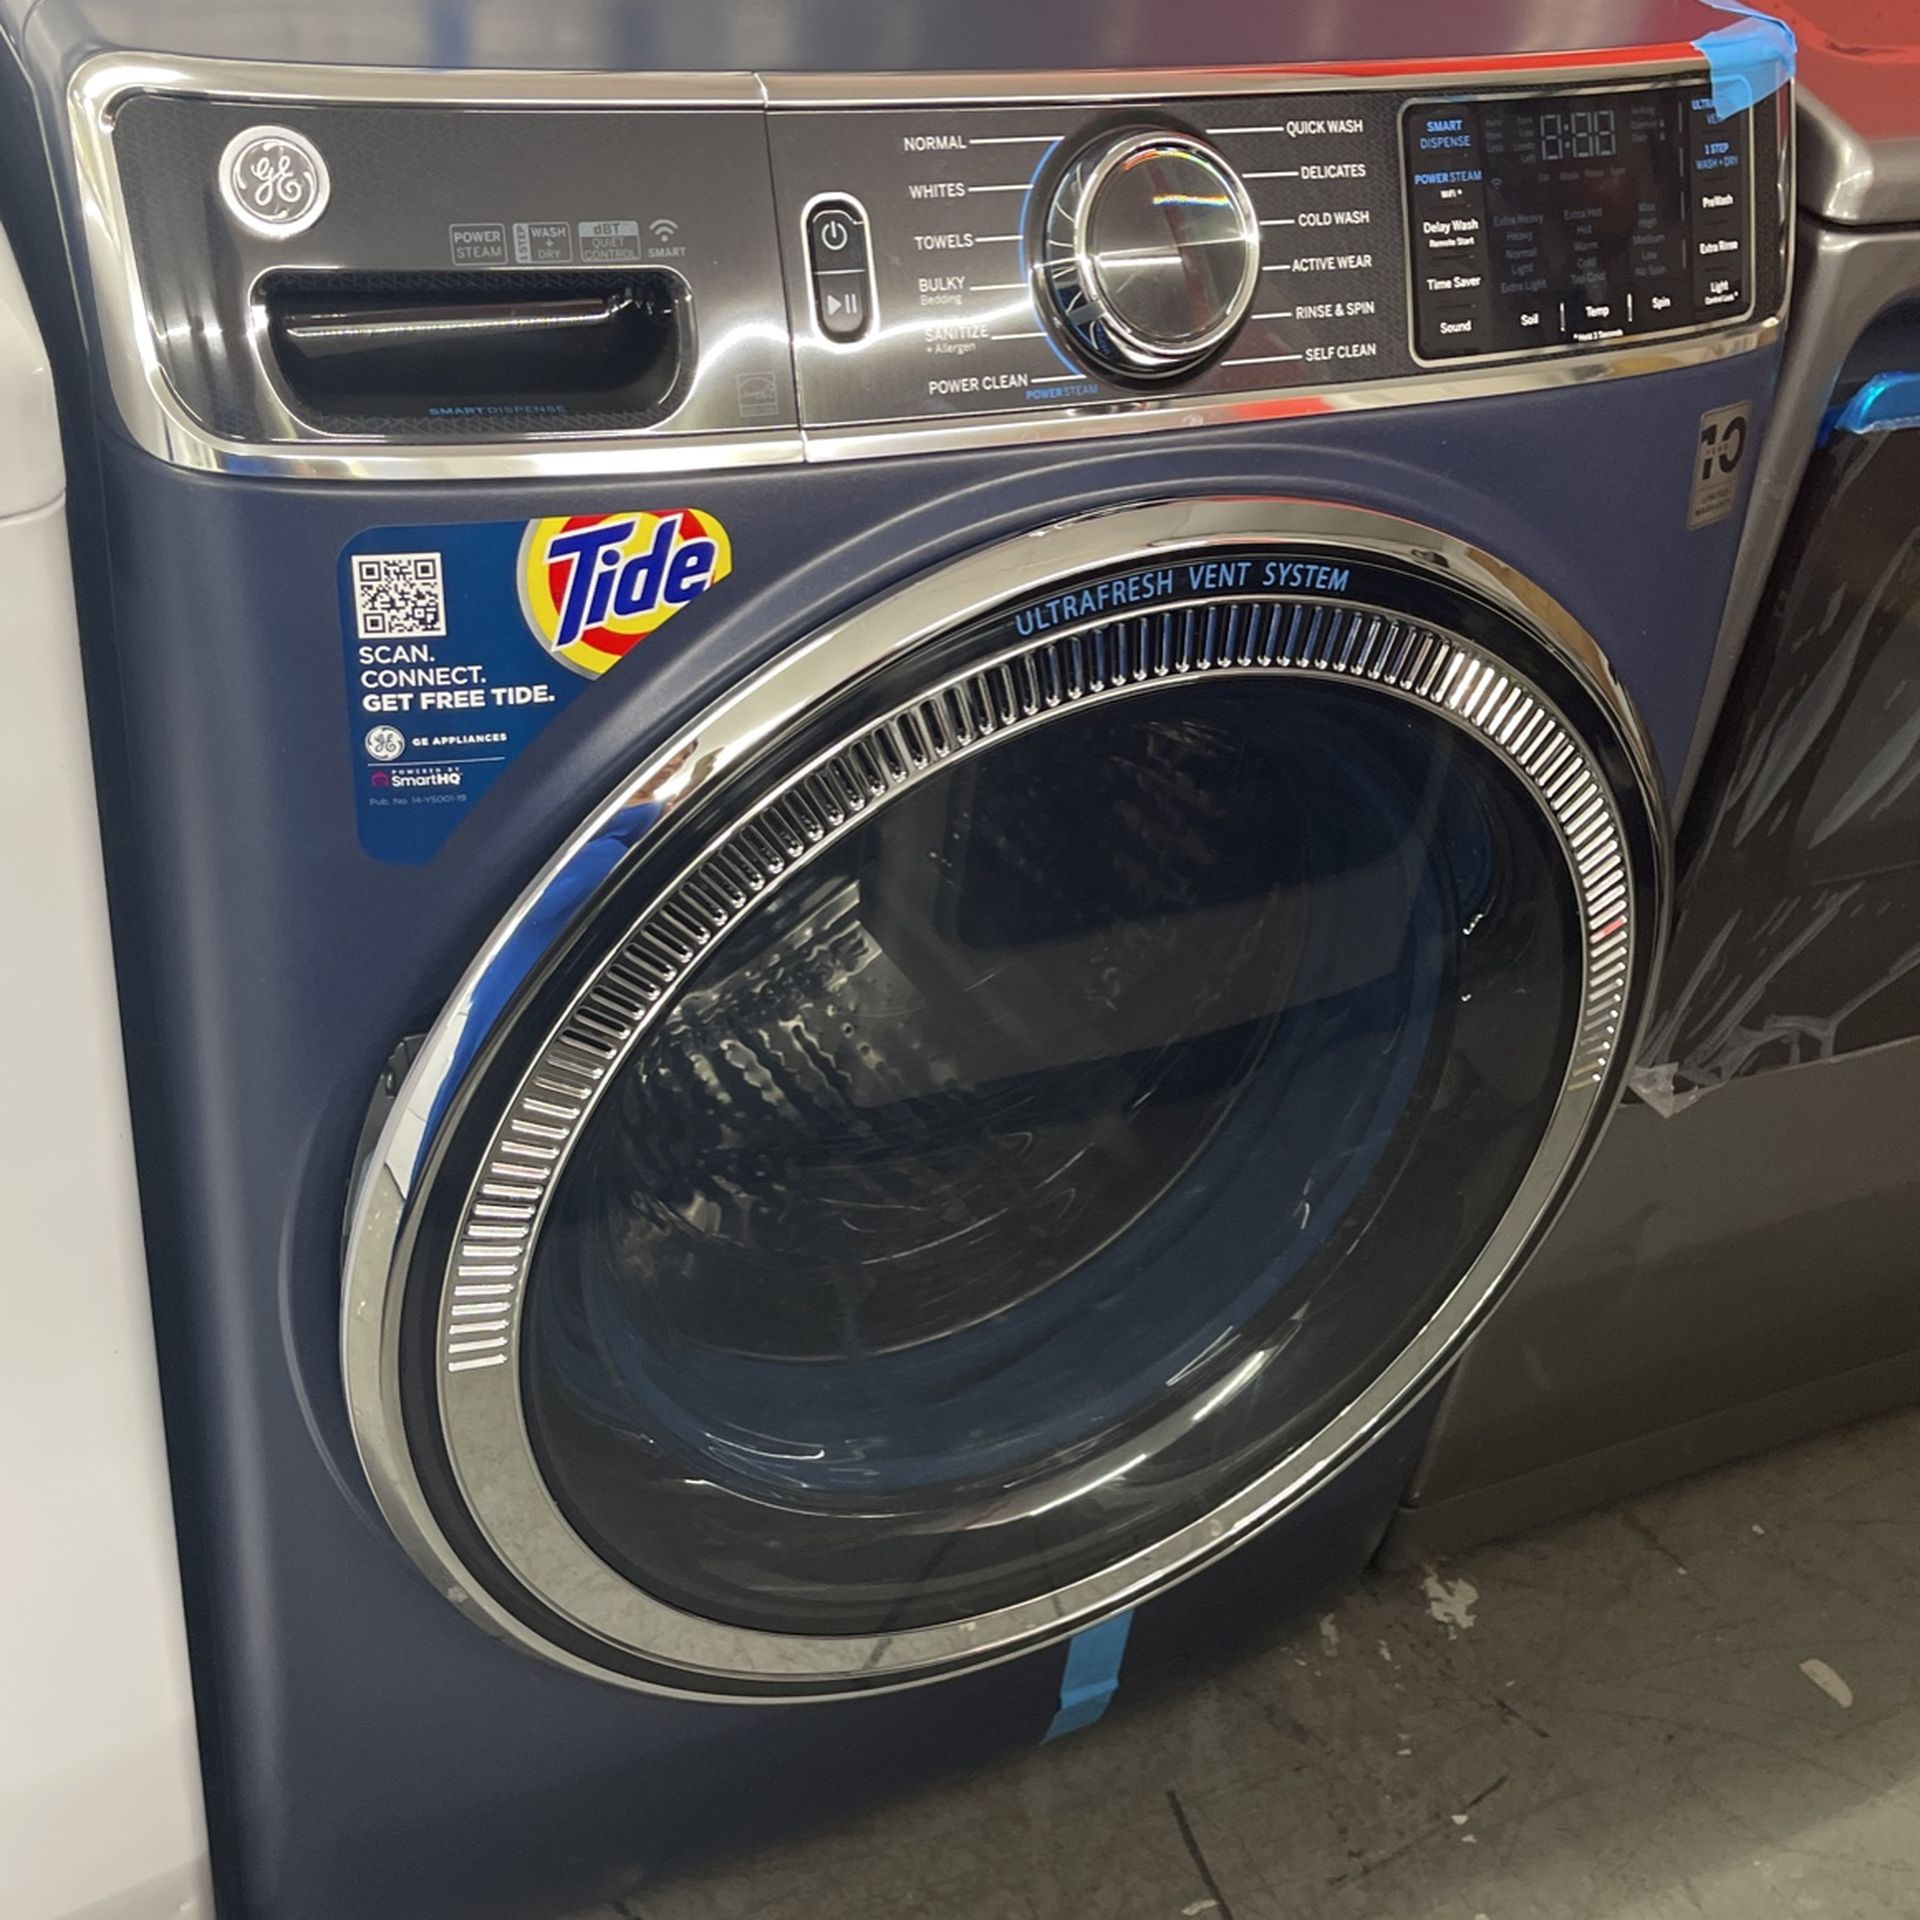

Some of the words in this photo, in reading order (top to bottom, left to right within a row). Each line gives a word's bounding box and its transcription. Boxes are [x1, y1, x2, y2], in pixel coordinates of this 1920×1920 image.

[1286, 120, 1326, 138] QUICK
[1326, 119, 1364, 133] WASH
[1426, 119, 1463, 132] SMART
[903, 135, 967, 151] NORMAL
[1420, 135, 1471, 149] DISPENSE
[1710, 142, 1729, 154] STEP
[1696, 159, 1718, 170] WASH
[1724, 155, 1738, 167] DRY
[1301, 163, 1366, 180] DELICATES
[908, 182, 966, 199] WHITES
[1298, 212, 1332, 227] COLD
[1333, 210, 1370, 224] WASH
[531, 227, 566, 238] WASH
[1423, 220, 1450, 234] Delay
[1451, 218, 1479, 231] Wash
[454, 231, 501, 243] POWER
[592, 237, 624, 248] QUIET
[914, 233, 974, 251] TOWELS
[1456, 237, 1474, 246] Start
[457, 246, 502, 259] STEAM
[584, 248, 634, 260] CONTROL
[649, 246, 687, 258] SMART
[1700, 242, 1719, 254] Extra
[1719, 240, 1738, 252] Rinse
[538, 249, 561, 260] DRY
[1292, 256, 1336, 272] ACTIVE
[1336, 254, 1372, 269] WEAR
[918, 276, 965, 293] BULKY
[1427, 278, 1452, 290] Time
[1452, 276, 1481, 288] Saver
[1710, 280, 1728, 294] Light
[920, 295, 963, 306] Bedding
[1652, 296, 1671, 310] Spin
[1295, 304, 1333, 319] RINSE
[1334, 303, 1344, 317] &
[1346, 301, 1375, 316] SPIN
[1585, 305, 1609, 317] Temp
[1520, 313, 1539, 326] Soil
[925, 324, 989, 342] SANITIZE
[1440, 320, 1472, 334] Sound
[935, 342, 976, 355] Allergen
[1305, 346, 1335, 362] SELF
[1336, 343, 1377, 358] CLEAN
[928, 378, 979, 395] POWER
[982, 374, 1028, 390] CLEAN
[1702, 416, 1747, 480] 10
[545, 512, 716, 652] Tide
[1015, 570, 1173, 636] ULTRAFRESH
[1189, 561, 1251, 591] VENT
[1263, 561, 1349, 592] SYSTEM
[358, 645, 435, 664] SCAN.
[361, 665, 487, 688] CONNECT.
[362, 693, 413, 712] GET
[420, 689, 485, 710] FREE
[491, 684, 555, 706] TIDE.
[412, 737, 429, 746] GE
[432, 733, 507, 746] APPLIANCES
[392, 772, 461, 787] SmartHQ
